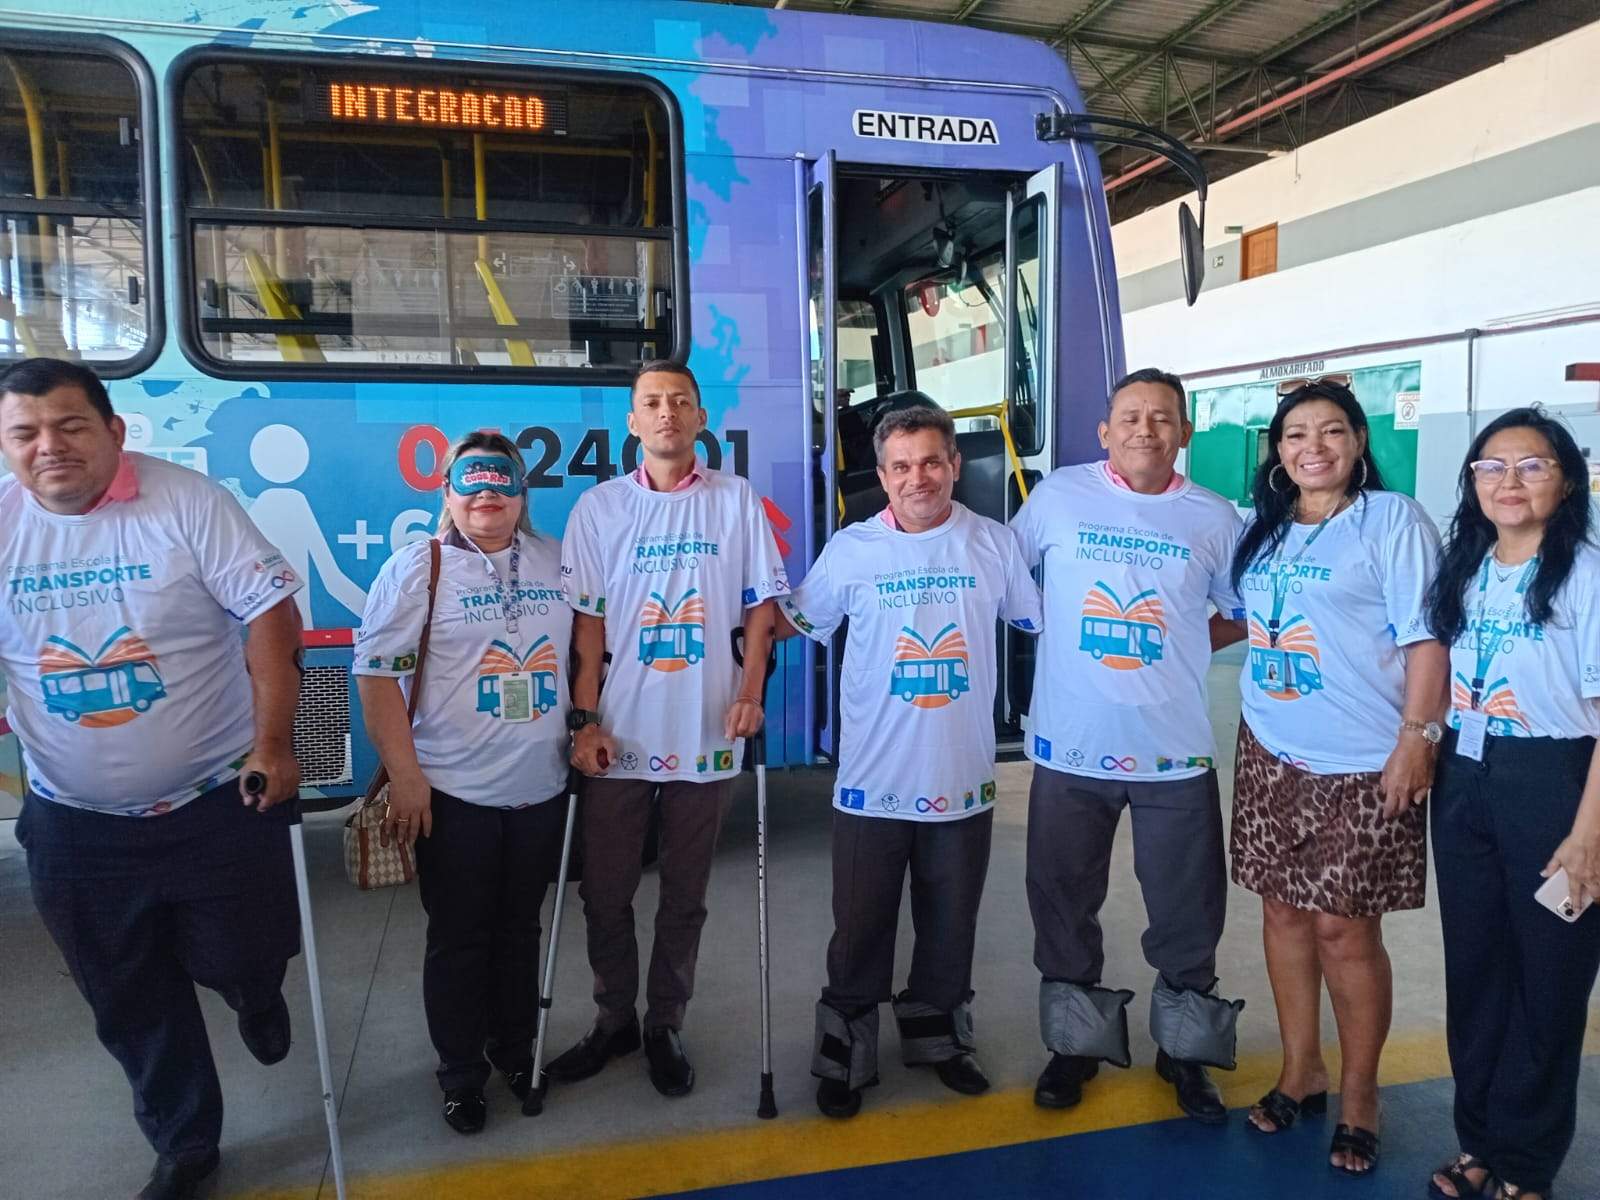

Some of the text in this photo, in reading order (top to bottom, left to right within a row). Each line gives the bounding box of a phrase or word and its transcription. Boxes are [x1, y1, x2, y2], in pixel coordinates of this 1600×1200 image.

[330, 84, 545, 128] INTEGRACAO
[858, 112, 997, 144] ENTRADA
[1260, 360, 1325, 379] ALMOXARIFADO
[396, 424, 749, 492] 0241
[1078, 521, 1175, 541] Programa Escola de
[636, 541, 719, 559] RANSPORTE
[1077, 531, 1191, 561] TRANSPORTE
[71, 554, 112, 568] Escola
[1076, 547, 1163, 570] INCLUSIVO
[9, 564, 153, 595] TRANSPORTE
[874, 565, 960, 582] Programa Escola de
[1248, 561, 1332, 581] ANPORTE
[456, 583, 502, 597] Program
[876, 576, 977, 595] TRANSPORTE
[10, 586, 125, 615] INCLUSIVO
[460, 589, 564, 608] TRANPORTE
[878, 591, 957, 610] INCLUSIVO
[1463, 619, 1544, 641] NSPORTE
